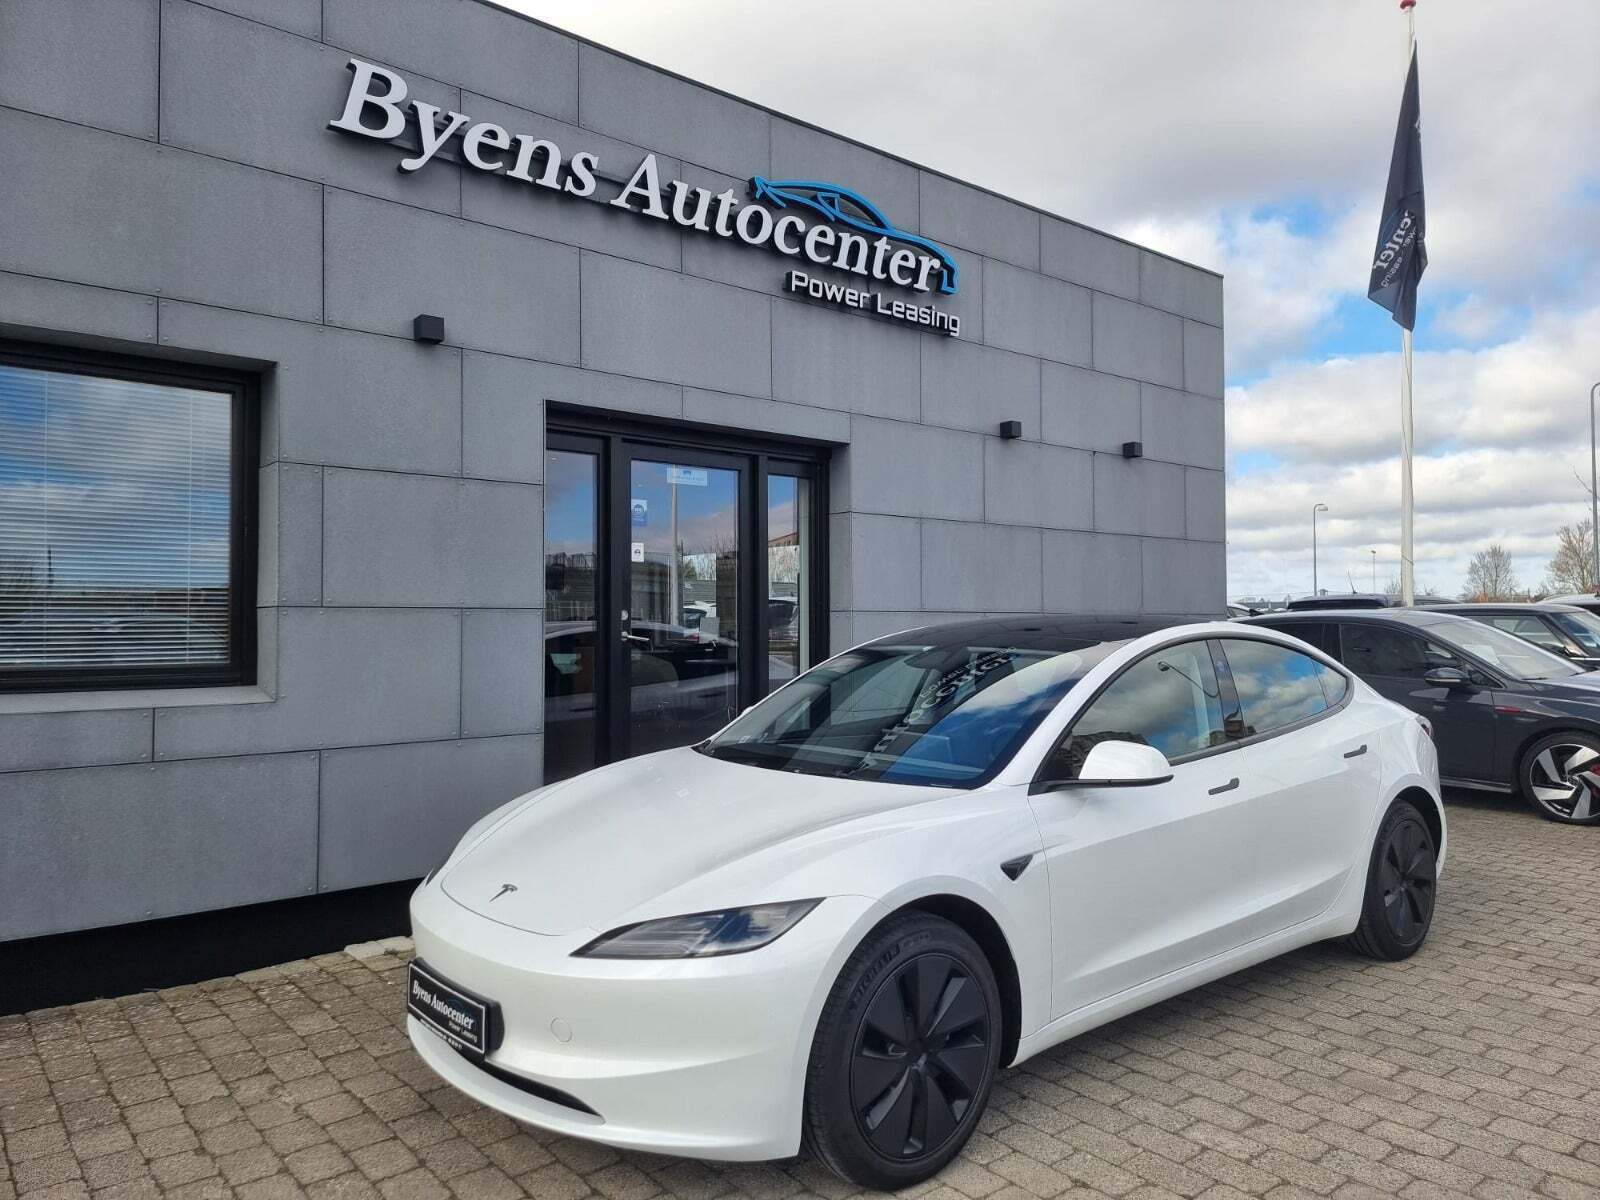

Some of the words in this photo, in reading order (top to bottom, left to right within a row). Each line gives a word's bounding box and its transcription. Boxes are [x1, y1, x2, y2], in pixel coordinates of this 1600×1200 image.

[329, 57, 600, 196] Byens
[611, 153, 941, 292] Autocenter
[791, 270, 872, 309] Power
[876, 292, 961, 337] Leasing
[412, 980, 432, 1004] Byens
[430, 994, 474, 1029] Autocenter
